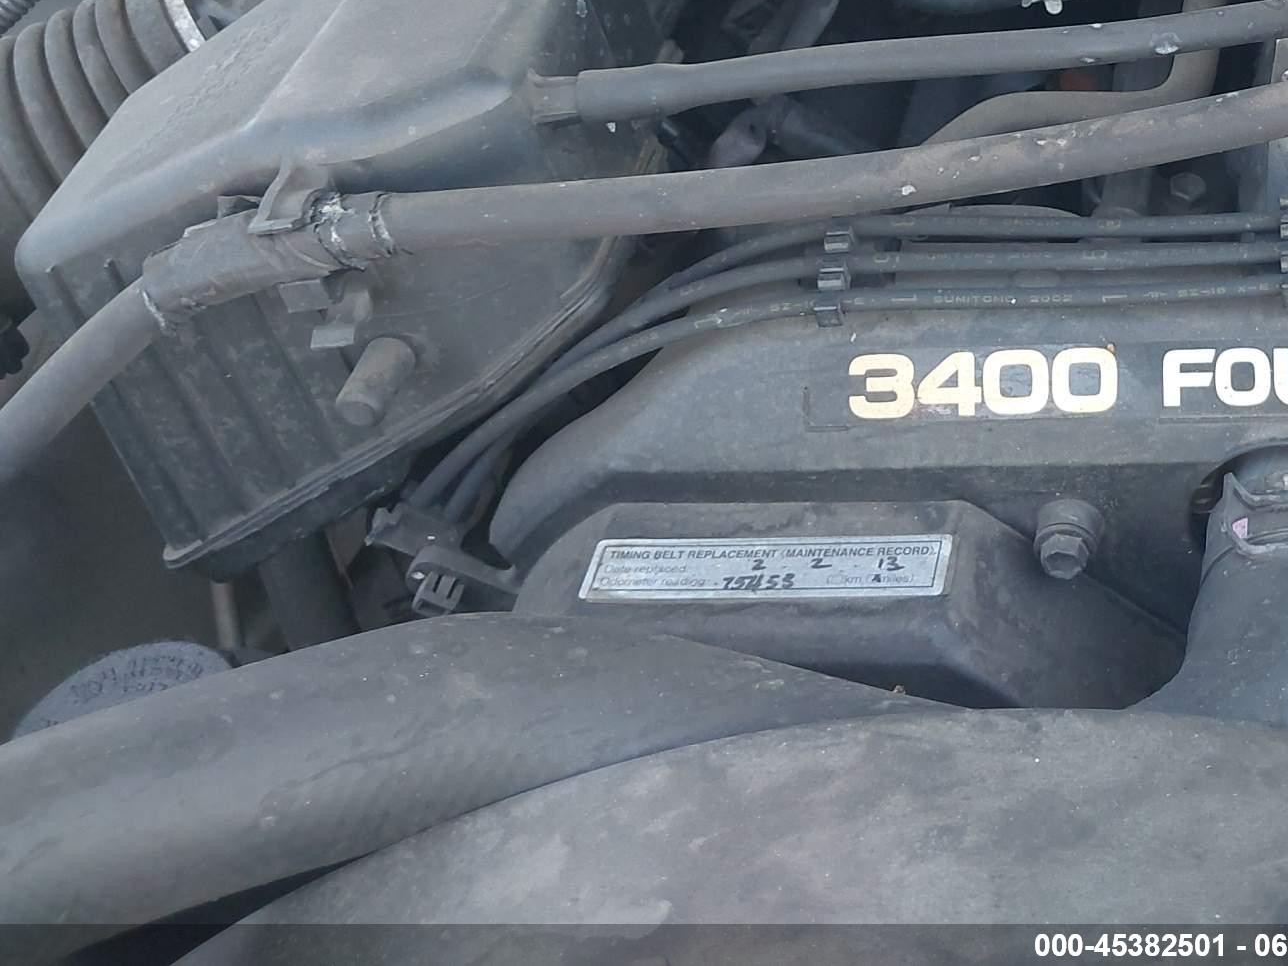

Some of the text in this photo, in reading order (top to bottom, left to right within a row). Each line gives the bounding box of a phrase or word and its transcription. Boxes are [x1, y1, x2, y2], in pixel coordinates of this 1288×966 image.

[1030, 293, 1073, 304] 2002
[848, 347, 1118, 420] 3400
[610, 550, 651, 560] TIMING
[654, 549, 685, 560] BELT
[687, 549, 777, 559] REPLACEMENT
